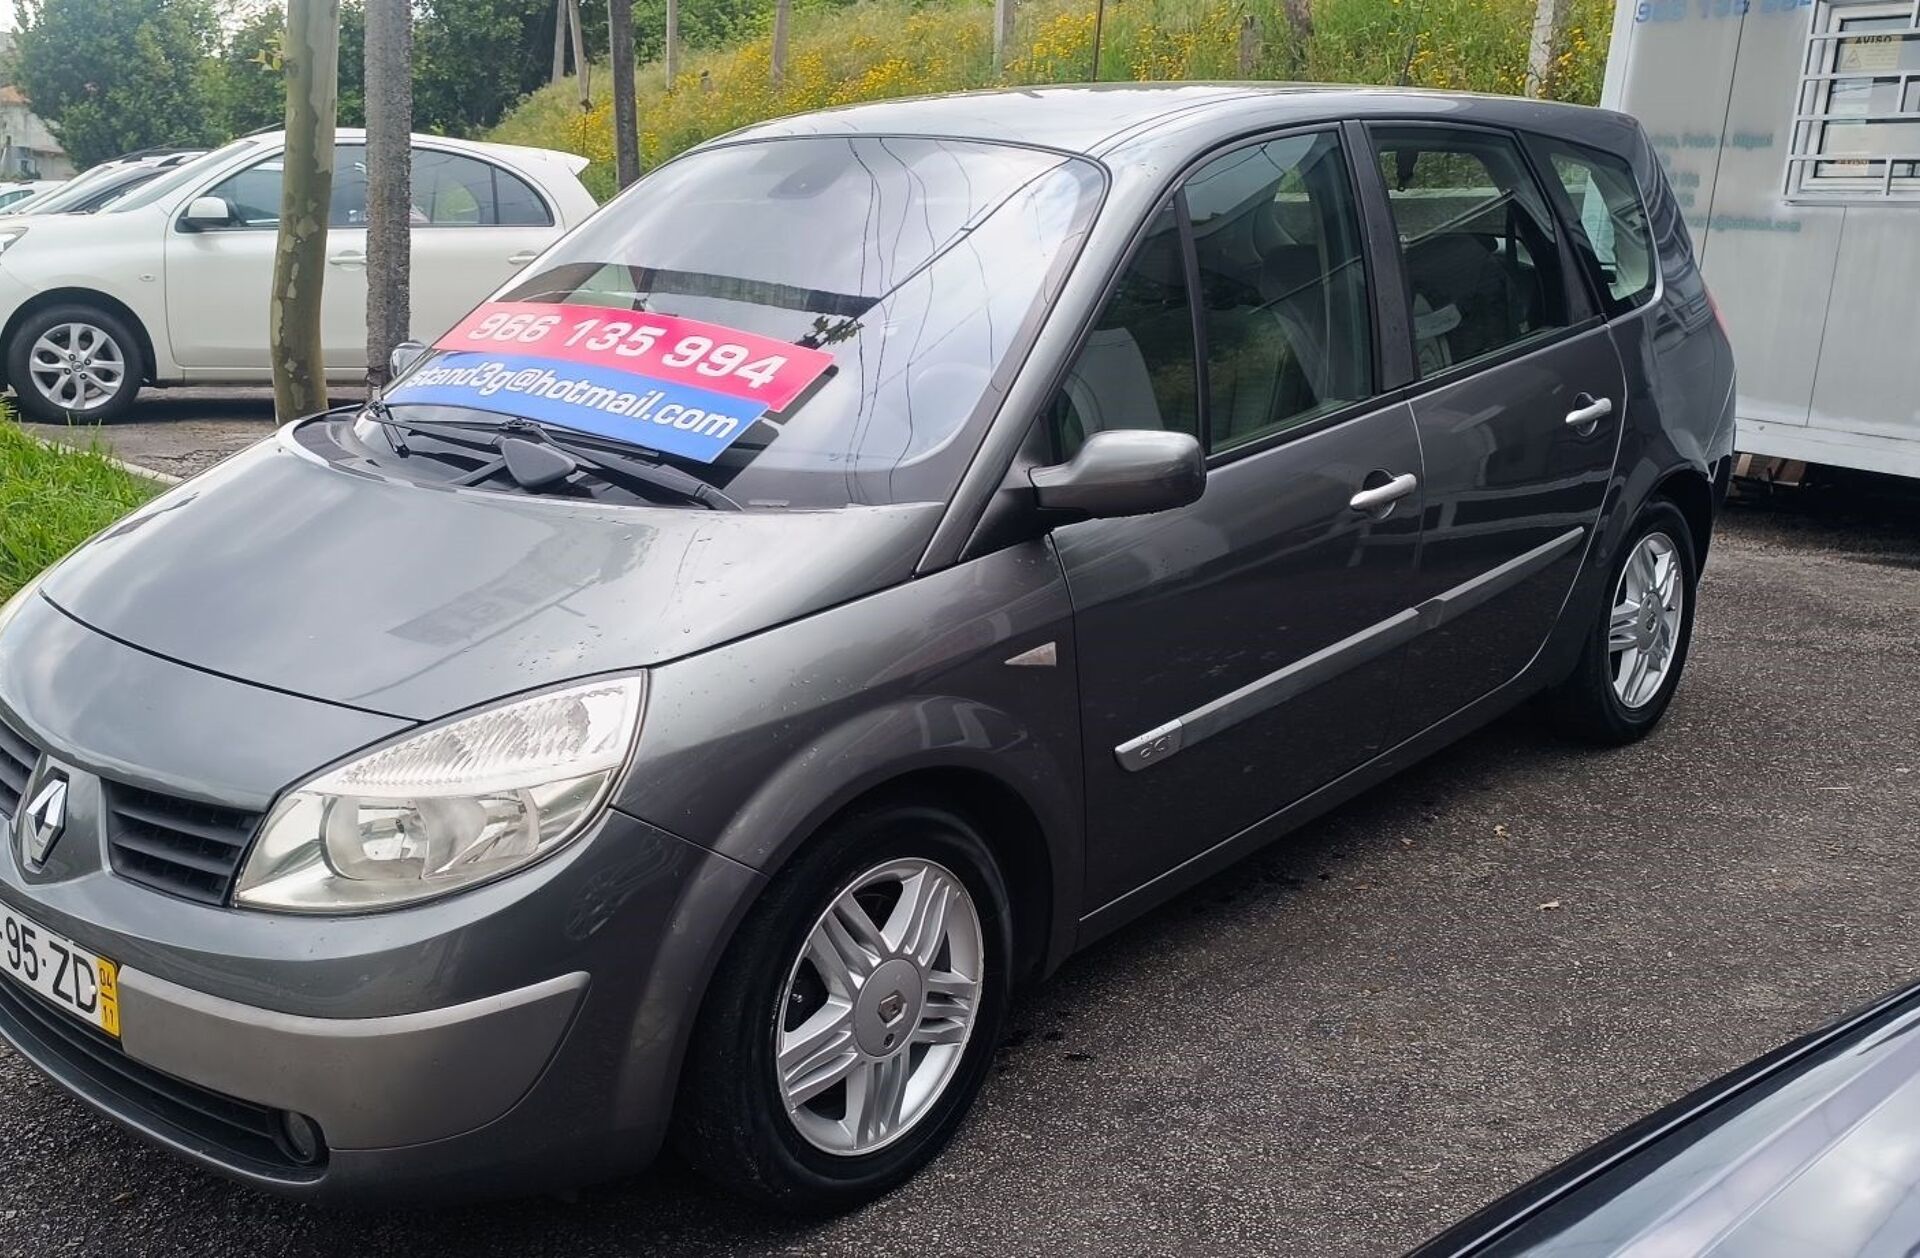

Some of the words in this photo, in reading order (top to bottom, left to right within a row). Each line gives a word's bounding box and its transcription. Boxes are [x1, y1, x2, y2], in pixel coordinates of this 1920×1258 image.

[468, 312, 561, 343] 966
[563, 318, 666, 358] 135
[661, 336, 788, 389] 994
[405, 361, 739, 438] stand3g@hotmail.com
